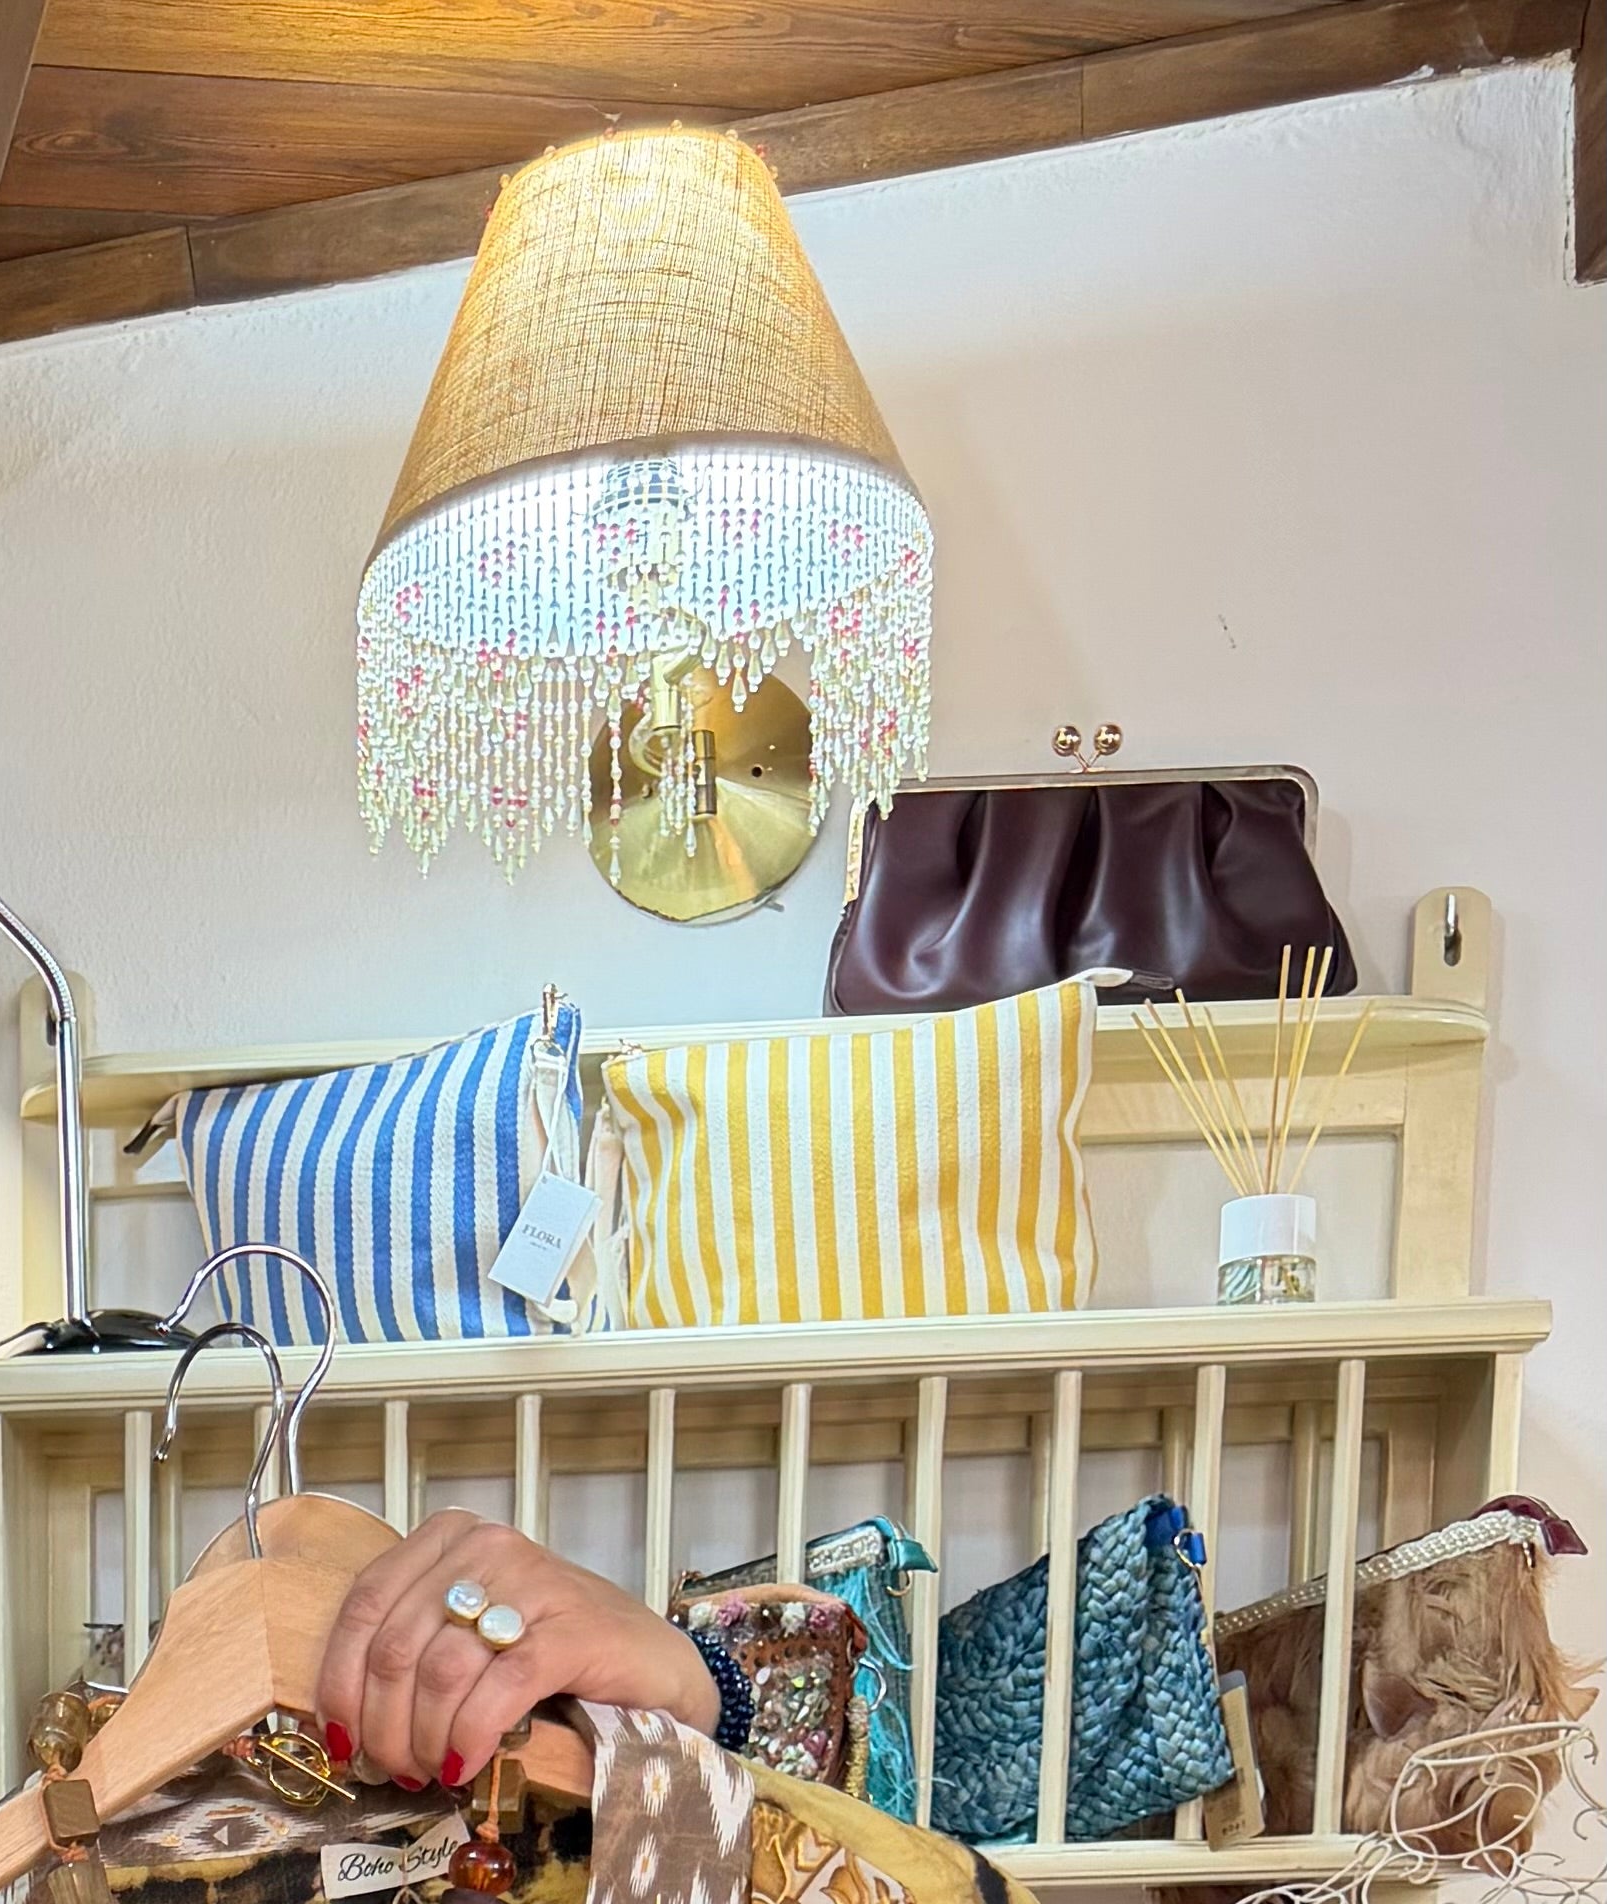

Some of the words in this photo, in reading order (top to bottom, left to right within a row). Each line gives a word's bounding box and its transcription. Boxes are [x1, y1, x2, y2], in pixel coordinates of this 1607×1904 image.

[522, 1223, 562, 1249] FLORA
[337, 1853, 395, 1881] Boho
[398, 1837, 458, 1873] Style
